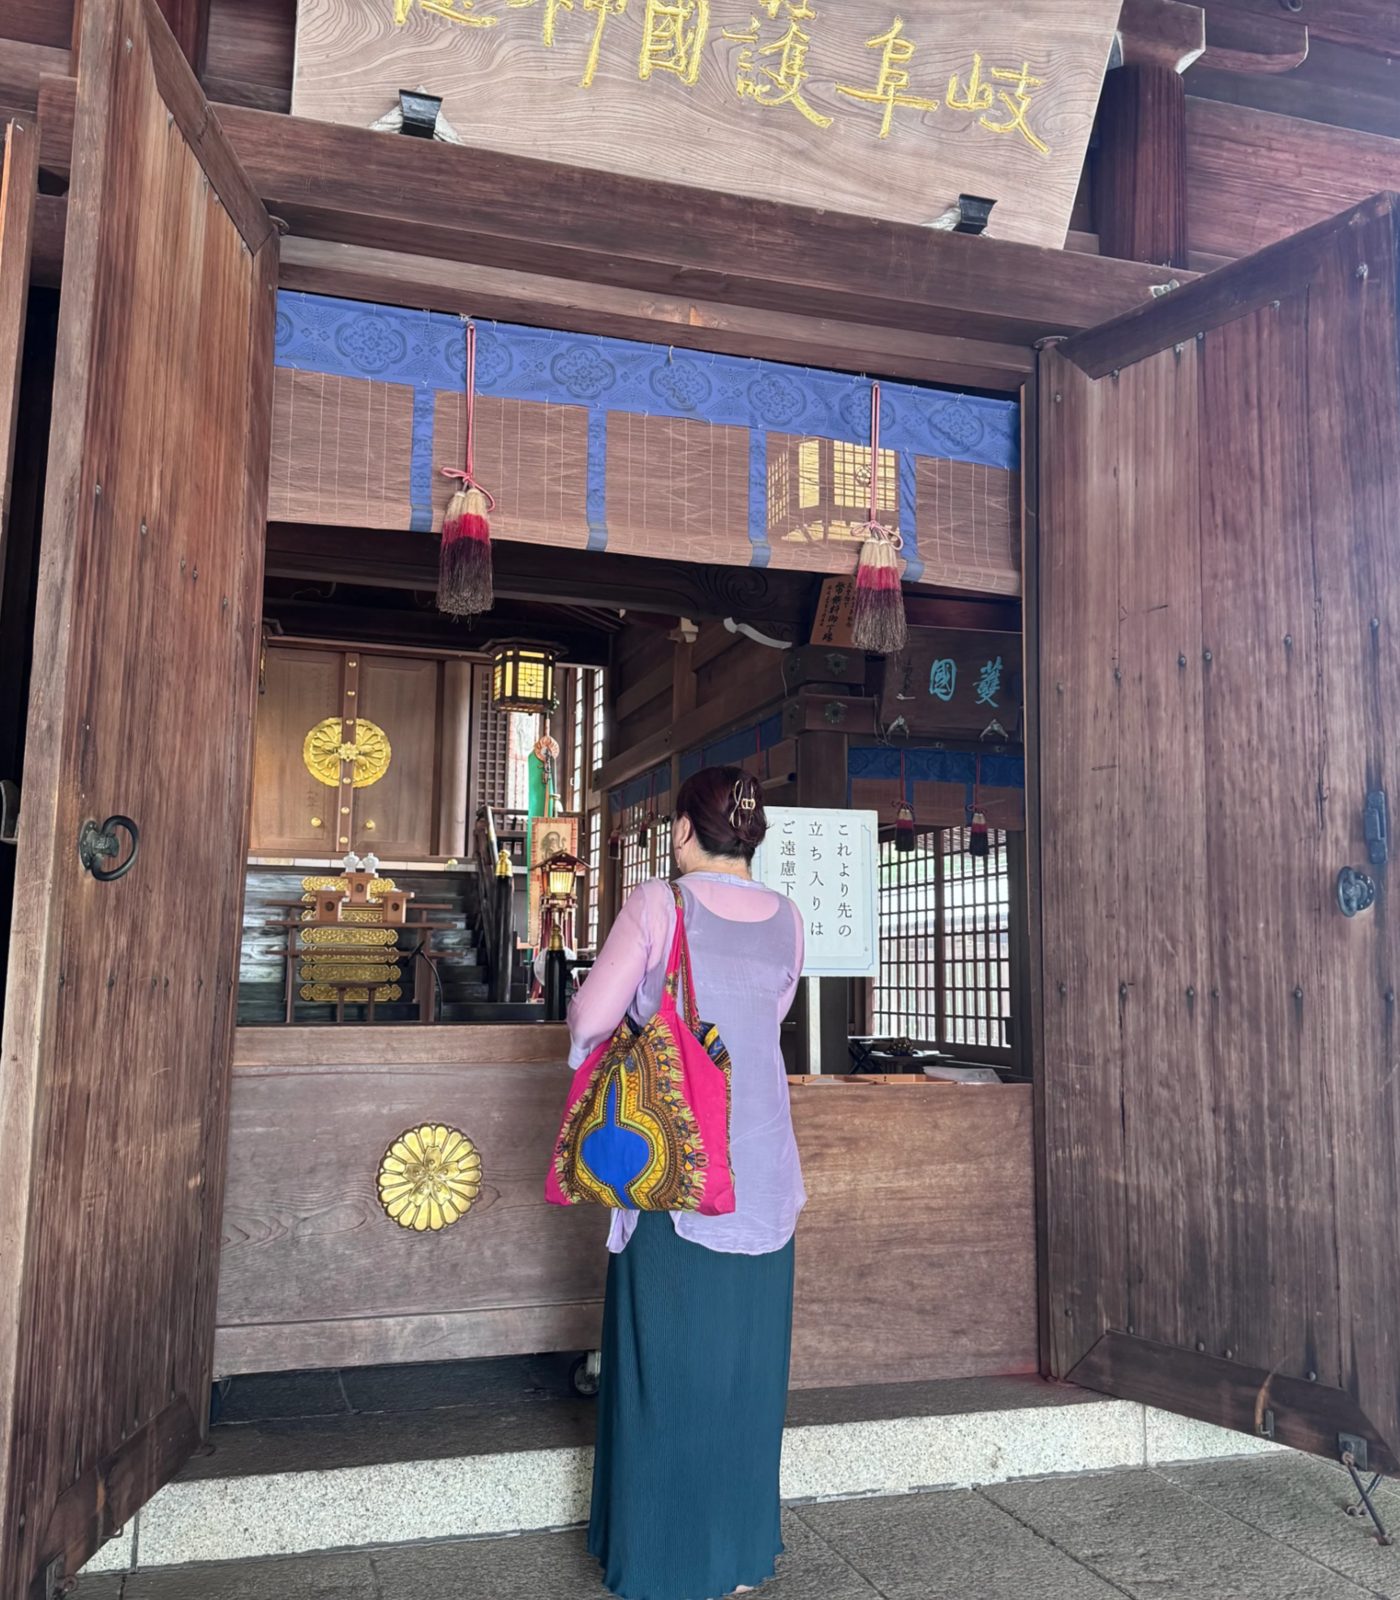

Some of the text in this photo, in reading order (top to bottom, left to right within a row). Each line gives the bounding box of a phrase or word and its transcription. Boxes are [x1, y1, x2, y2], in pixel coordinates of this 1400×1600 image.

[780, 820, 796, 897] ご遠慮下
[808, 821, 825, 936] 立ち入りは
[837, 824, 852, 938] これより先の
